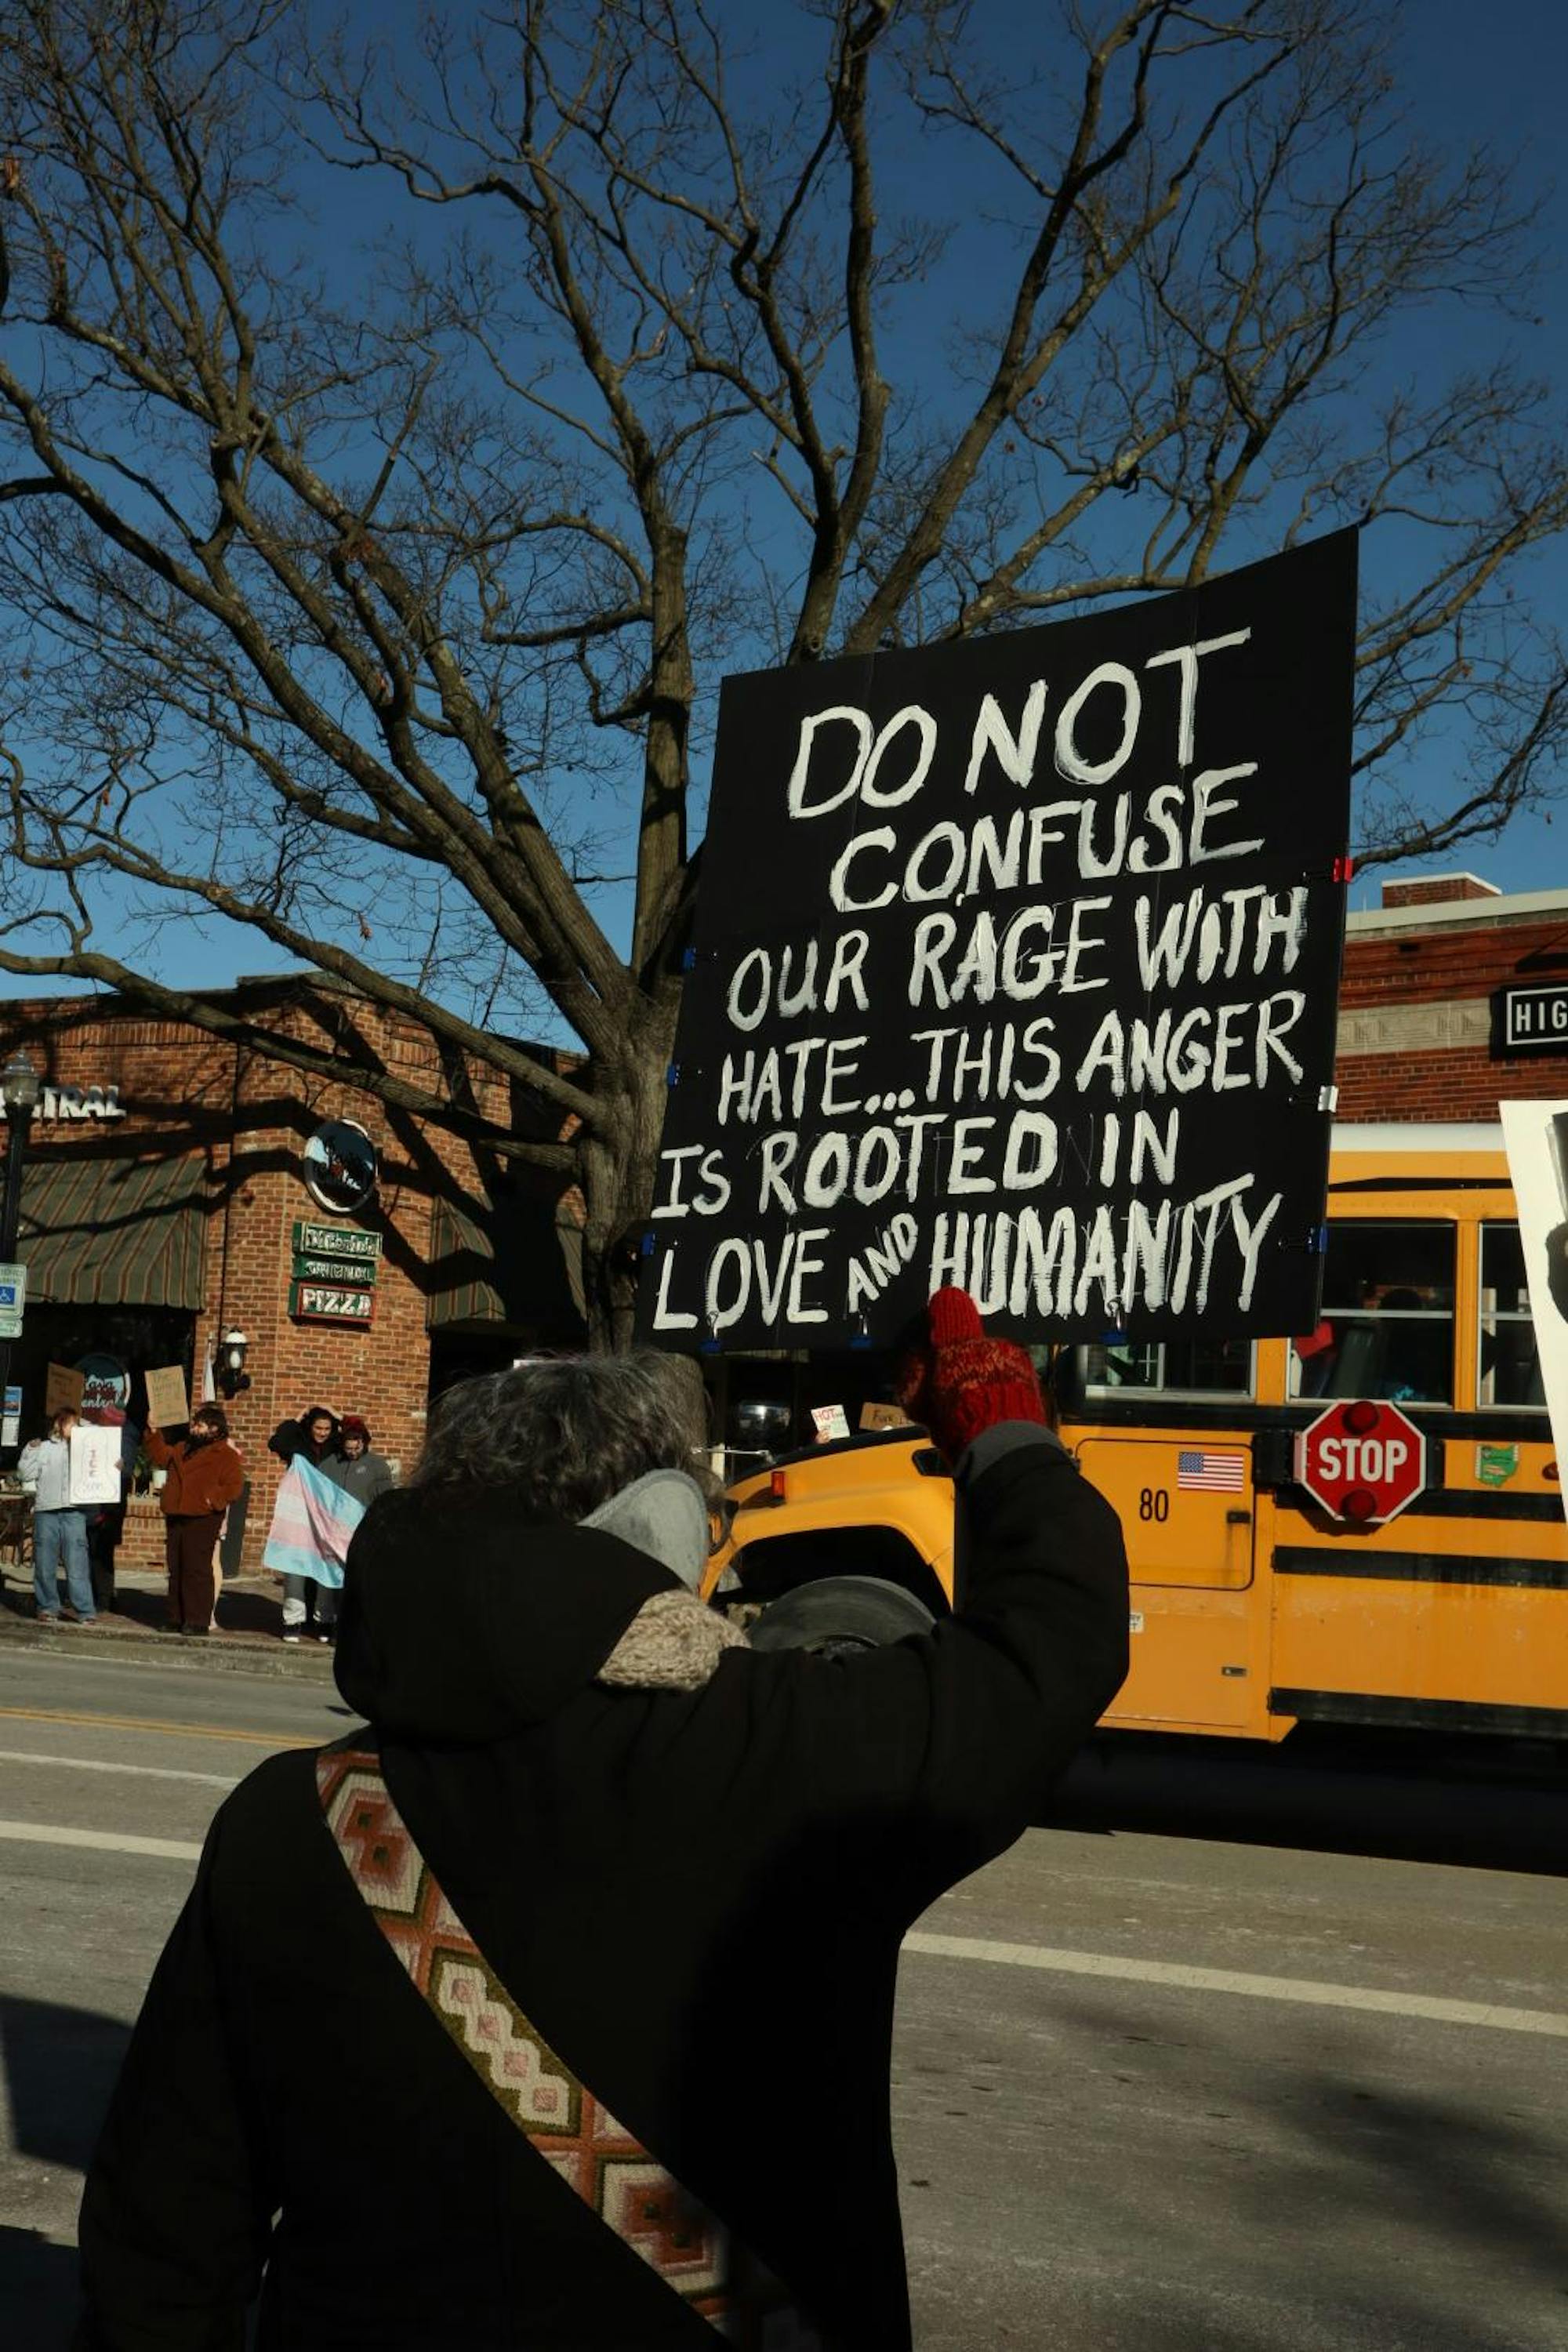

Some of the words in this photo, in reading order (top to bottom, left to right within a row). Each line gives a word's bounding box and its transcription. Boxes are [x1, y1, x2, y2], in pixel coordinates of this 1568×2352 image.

[789, 705, 937, 818] DO
[964, 627, 1250, 795] NOT
[829, 763, 1265, 912] CONFUSE
[728, 930, 869, 1031] OUR
[909, 896, 1112, 1010] RAGE
[1135, 885, 1308, 991] WITH
[909, 1018, 1060, 1102] THIS
[1076, 990, 1305, 1101] ANGER
[652, 1145, 731, 1218] IS
[759, 1109, 1058, 1214] ROOTED
[1100, 1108, 1178, 1187] IN
[302, 1288, 371, 1316] PIZZA
[653, 1228, 829, 1329] LOVE
[848, 1214, 918, 1312] AND
[929, 1173, 1282, 1319] HUMANITY
[1139, 1488, 1169, 1523] 80
[1319, 1439, 1408, 1483] STOP
